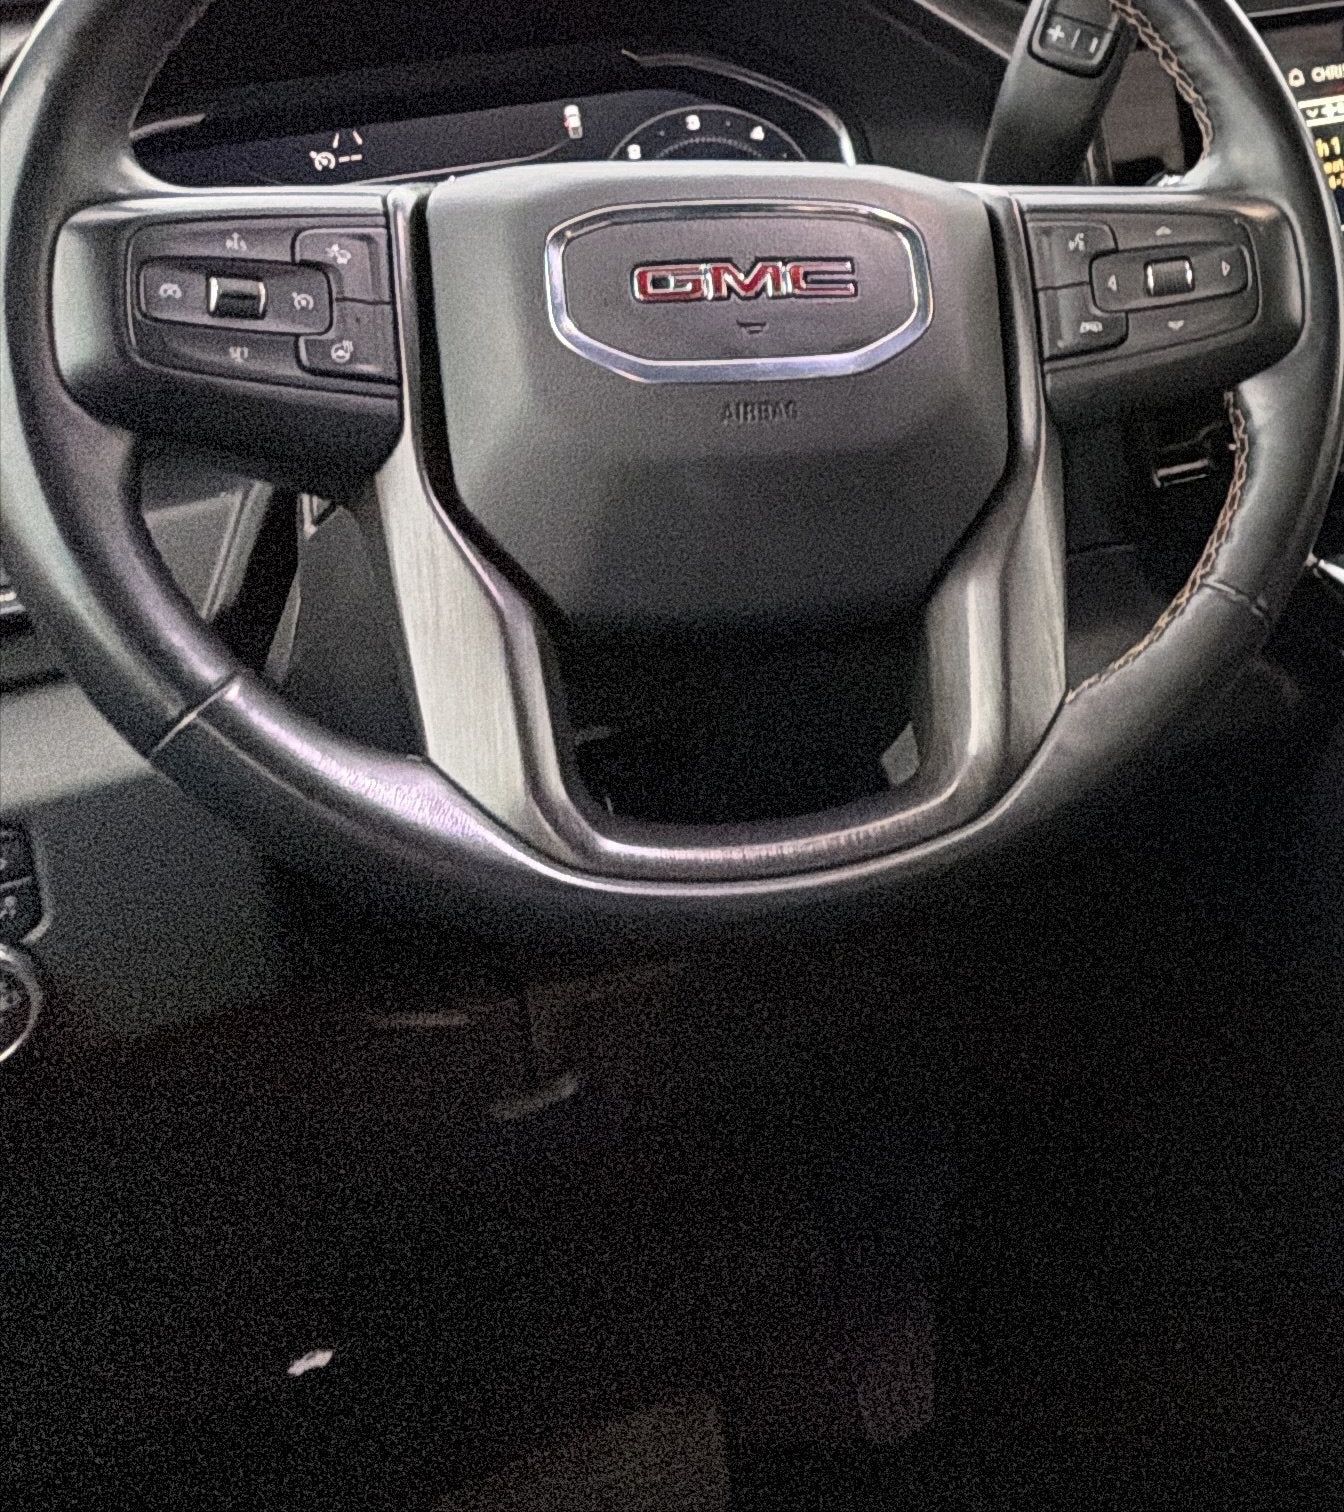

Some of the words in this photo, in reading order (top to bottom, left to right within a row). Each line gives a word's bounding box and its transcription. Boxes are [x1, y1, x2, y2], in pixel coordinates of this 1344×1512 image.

[1315, 137, 1330, 158] h
[1323, 157, 1344, 175] eat
[630, 256, 858, 303] GMC
[722, 399, 798, 425] AIRBAG
